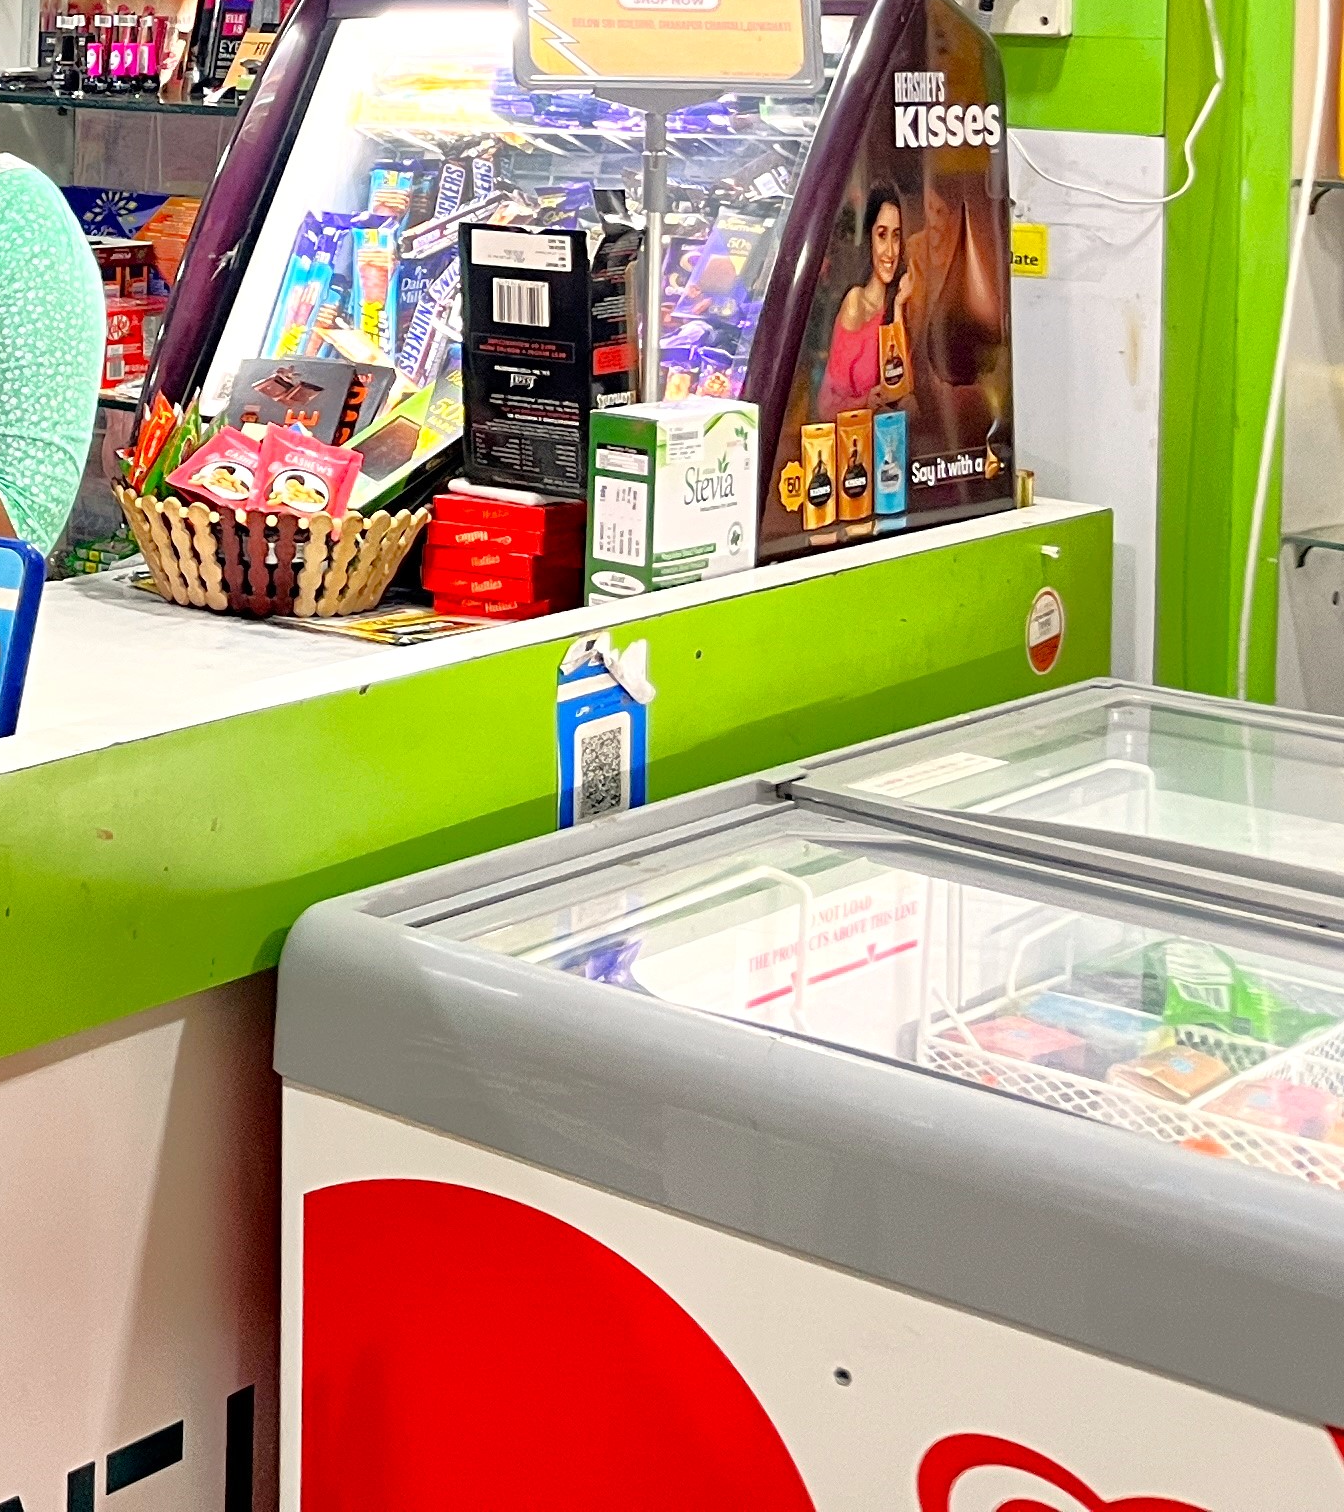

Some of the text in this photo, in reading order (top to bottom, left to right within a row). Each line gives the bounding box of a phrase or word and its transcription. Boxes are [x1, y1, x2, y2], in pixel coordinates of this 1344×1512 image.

[224, 13, 244, 24] ELLE
[894, 71, 945, 103] HERSHEY'S
[401, 277, 433, 292] Dairy
[401, 287, 425, 304] Milk
[400, 300, 436, 375] SNICKERS
[284, 453, 333, 477] CASHEWS
[911, 456, 983, 486] Say it with a
[683, 466, 736, 506] Stevia
[817, 895, 873, 924] NOT LOAD
[748, 899, 918, 974] THE ABOVE THIS LINE
